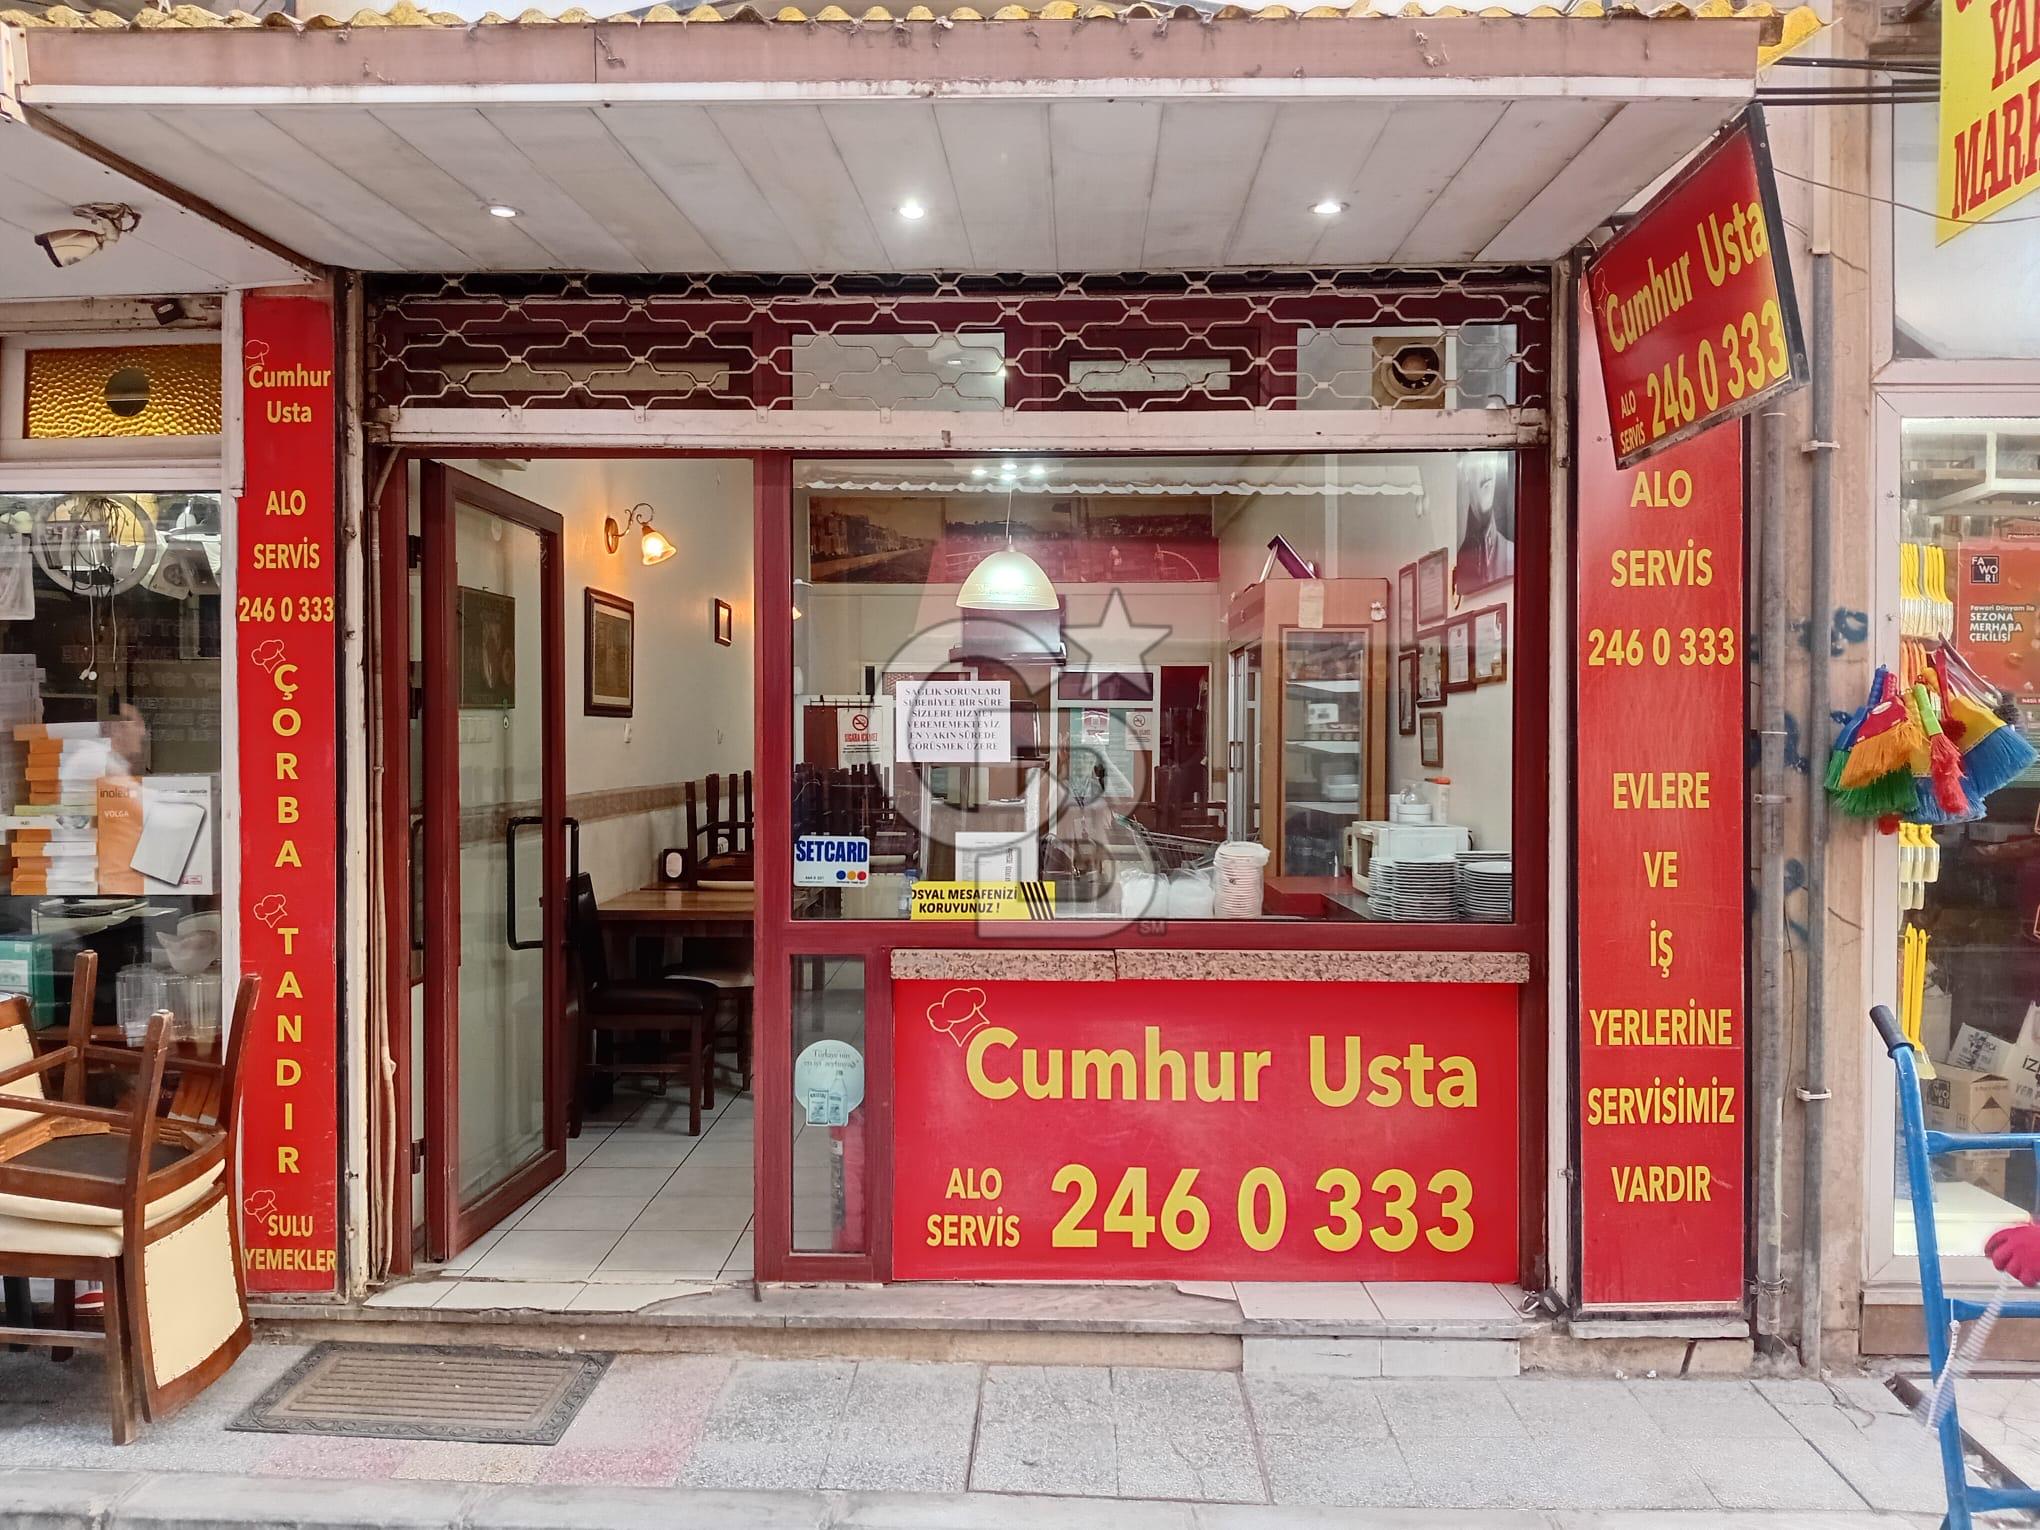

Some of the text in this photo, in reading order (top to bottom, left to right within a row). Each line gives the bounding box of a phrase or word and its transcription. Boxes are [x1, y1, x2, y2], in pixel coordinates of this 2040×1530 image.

[1607, 202, 1768, 352] Cumhur Usta
[249, 363, 332, 389] Cumhur
[1647, 299, 1788, 438] 246 0 333
[267, 400, 312, 423] Usta
[1620, 390, 1637, 418] ALO
[1620, 417, 1646, 454] SERVİS
[265, 490, 307, 516] ALO
[1630, 470, 1694, 508] ALO
[253, 536, 321, 570] SERVİS
[1611, 539, 1713, 587] SERVİS
[239, 596, 335, 622] 246 0 333
[1970, 612, 2014, 621] SEZONA
[1970, 623, 2023, 632] MERHABA
[1588, 628, 1735, 666] 246 0 333
[944, 687, 1001, 696] SORUNLARI
[272, 664, 302, 868] ÇORBA
[1613, 772, 1710, 809] EVLERE
[796, 841, 868, 862] SETCARD
[1643, 851, 1678, 888] VE
[919, 902, 993, 913] KORUYUNUZ
[948, 886, 1018, 900] MESAFENİZİ
[1650, 919, 1674, 978] İŞ
[1589, 998, 1733, 1046] YERLERİNE
[275, 927, 304, 1174] TANDIR
[965, 1026, 1478, 1108] Cumhur Usta
[2022, 1055, 2040, 1073] İZ
[1587, 1076, 1735, 1125] SERVİSİMİZ
[945, 1168, 1002, 1199] ALO
[1611, 1166, 1713, 1202] VARDIR
[1051, 1163, 1475, 1252] 246 0 333
[268, 1215, 314, 1237] SULU
[926, 1206, 1020, 1247] SERVİS
[245, 1248, 337, 1271] YEMEKLER
